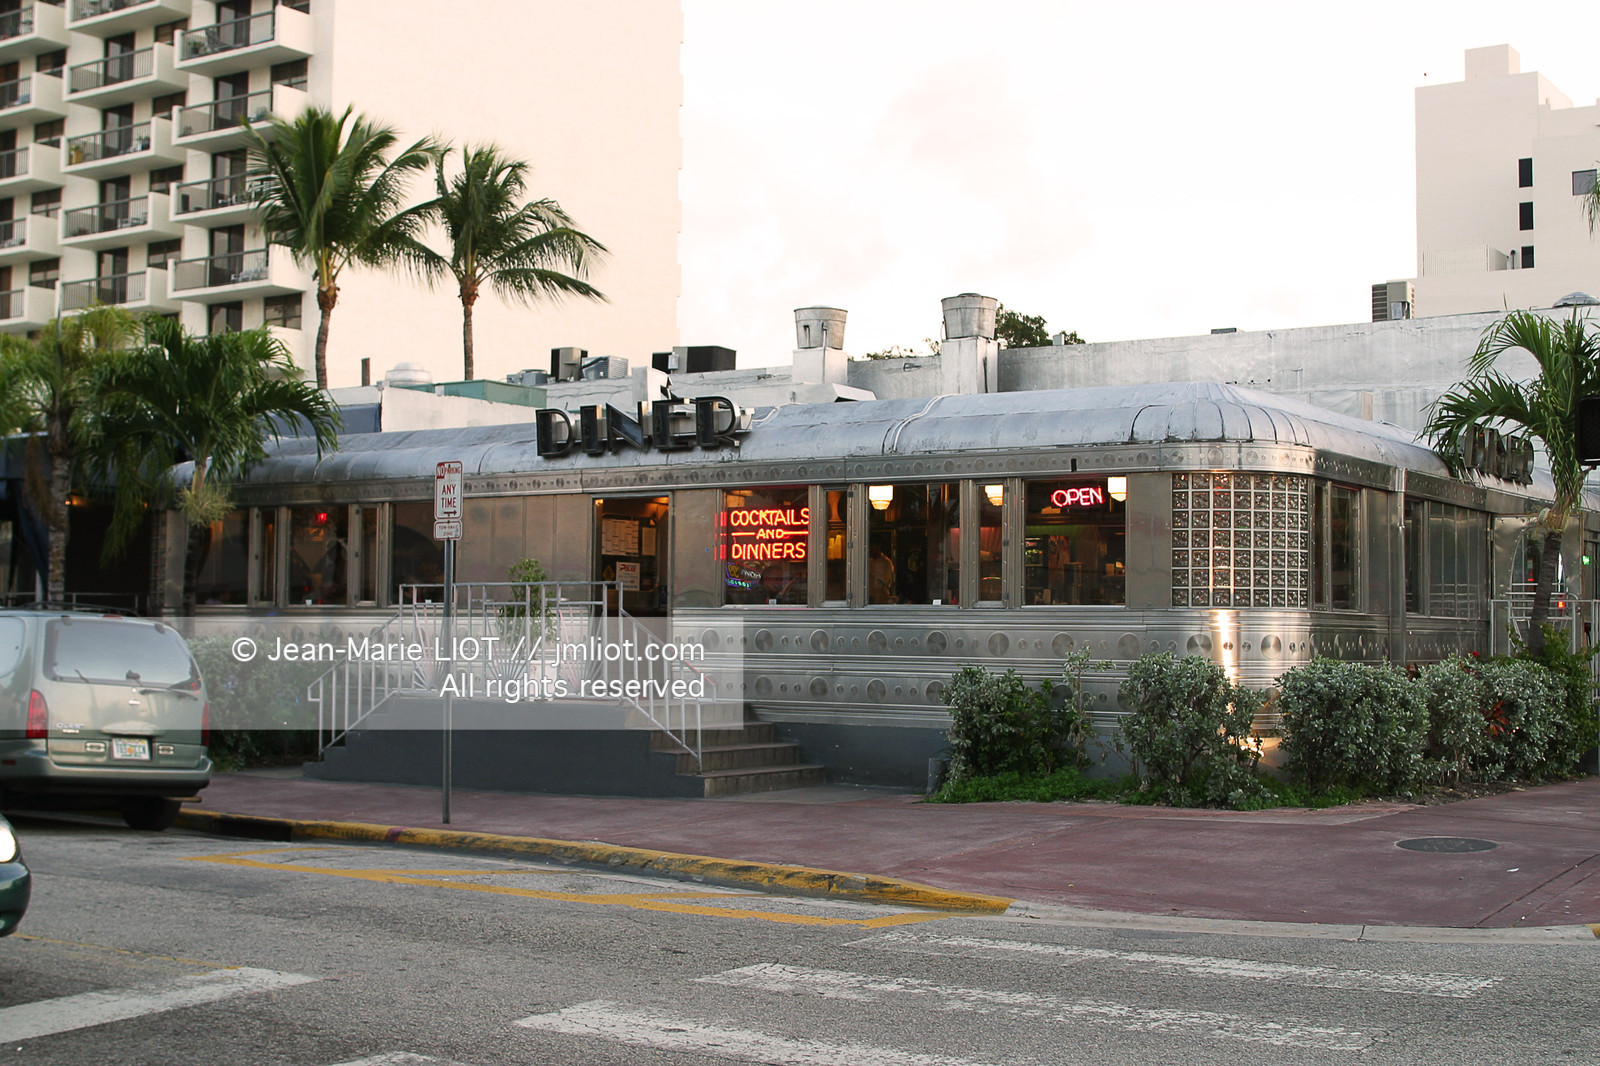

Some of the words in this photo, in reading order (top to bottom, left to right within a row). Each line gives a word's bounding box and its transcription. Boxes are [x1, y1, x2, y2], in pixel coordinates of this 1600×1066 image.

[536, 396, 740, 457] DINER
[441, 484, 456, 495] ANY
[1052, 487, 1103, 507] OPEN
[441, 497, 457, 508] TIME
[730, 507, 811, 526] COCKTAILS
[756, 528, 785, 540] AND
[731, 542, 806, 560] DINNERS
